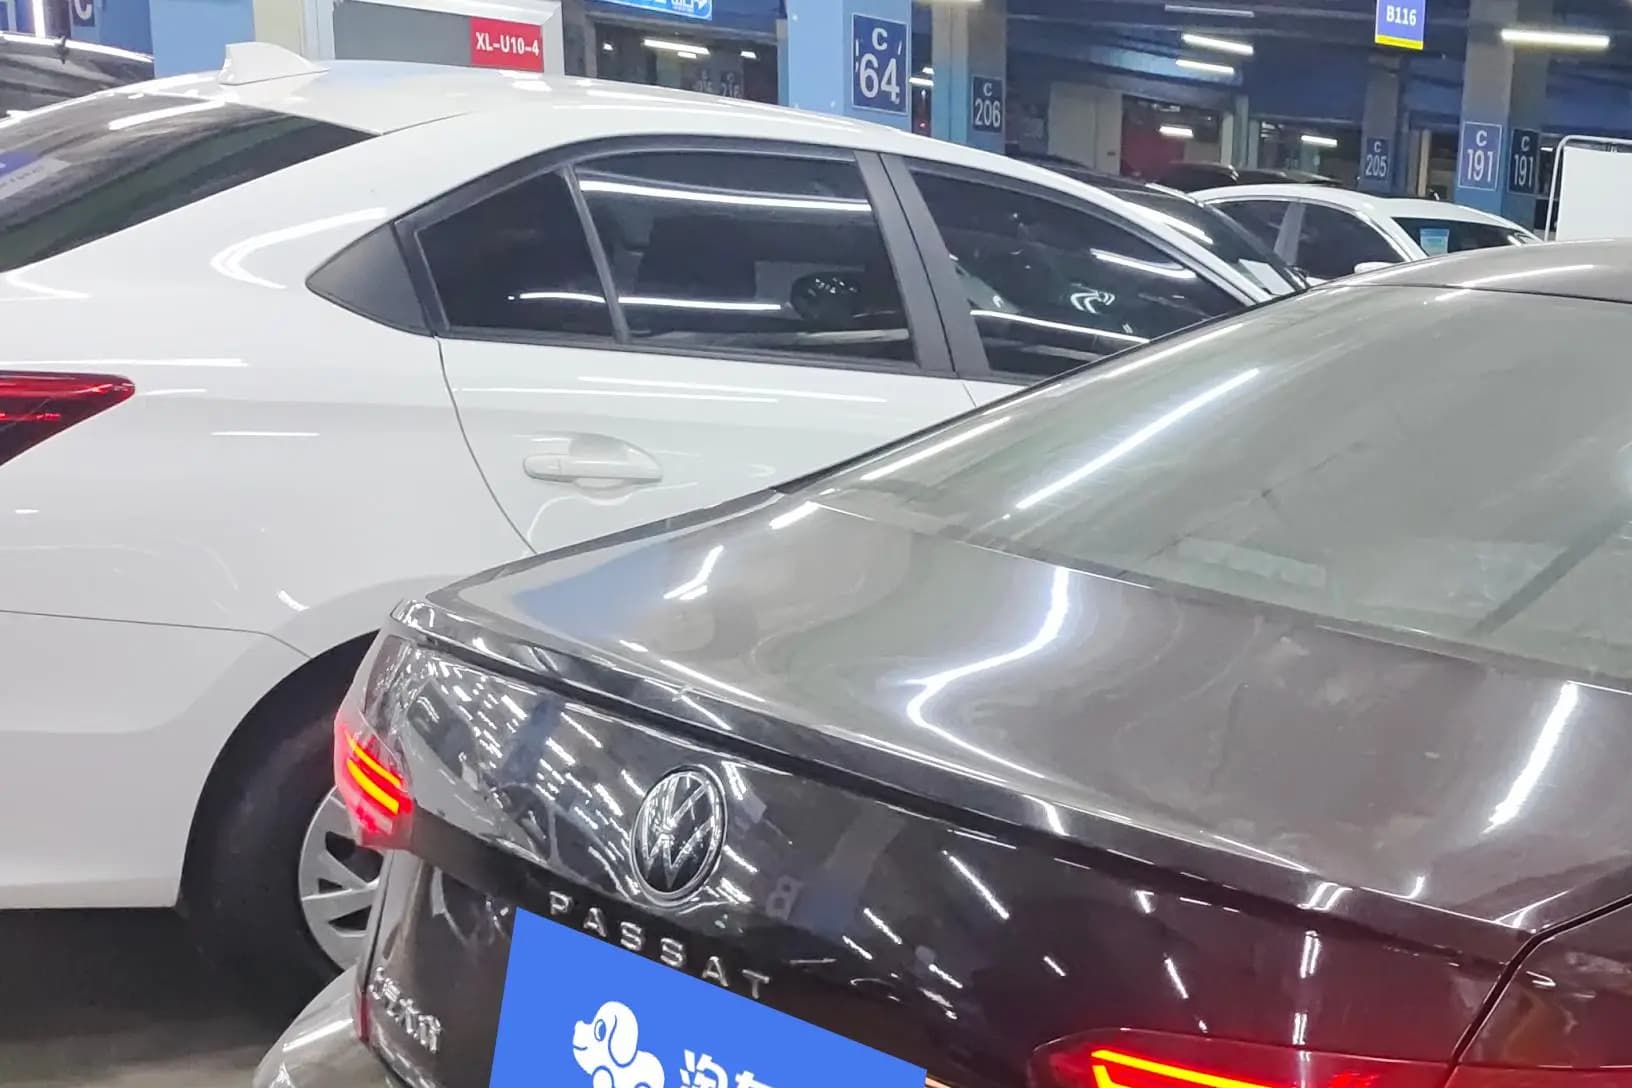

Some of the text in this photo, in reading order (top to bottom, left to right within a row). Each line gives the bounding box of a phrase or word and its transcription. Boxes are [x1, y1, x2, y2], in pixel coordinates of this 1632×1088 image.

[1386, 5, 1417, 26] B116
[475, 32, 540, 57] XL-U10-4
[872, 27, 888, 50] C
[859, 53, 900, 103] 64
[983, 83, 993, 97] C
[974, 99, 1001, 128] 206
[1374, 141, 1382, 153] C
[1476, 130, 1488, 147] C
[1521, 136, 1530, 151] C
[1365, 154, 1388, 177] 205
[1467, 149, 1494, 182] 191
[1514, 154, 1534, 187] 191
[549, 890, 771, 1000] PASSAT
